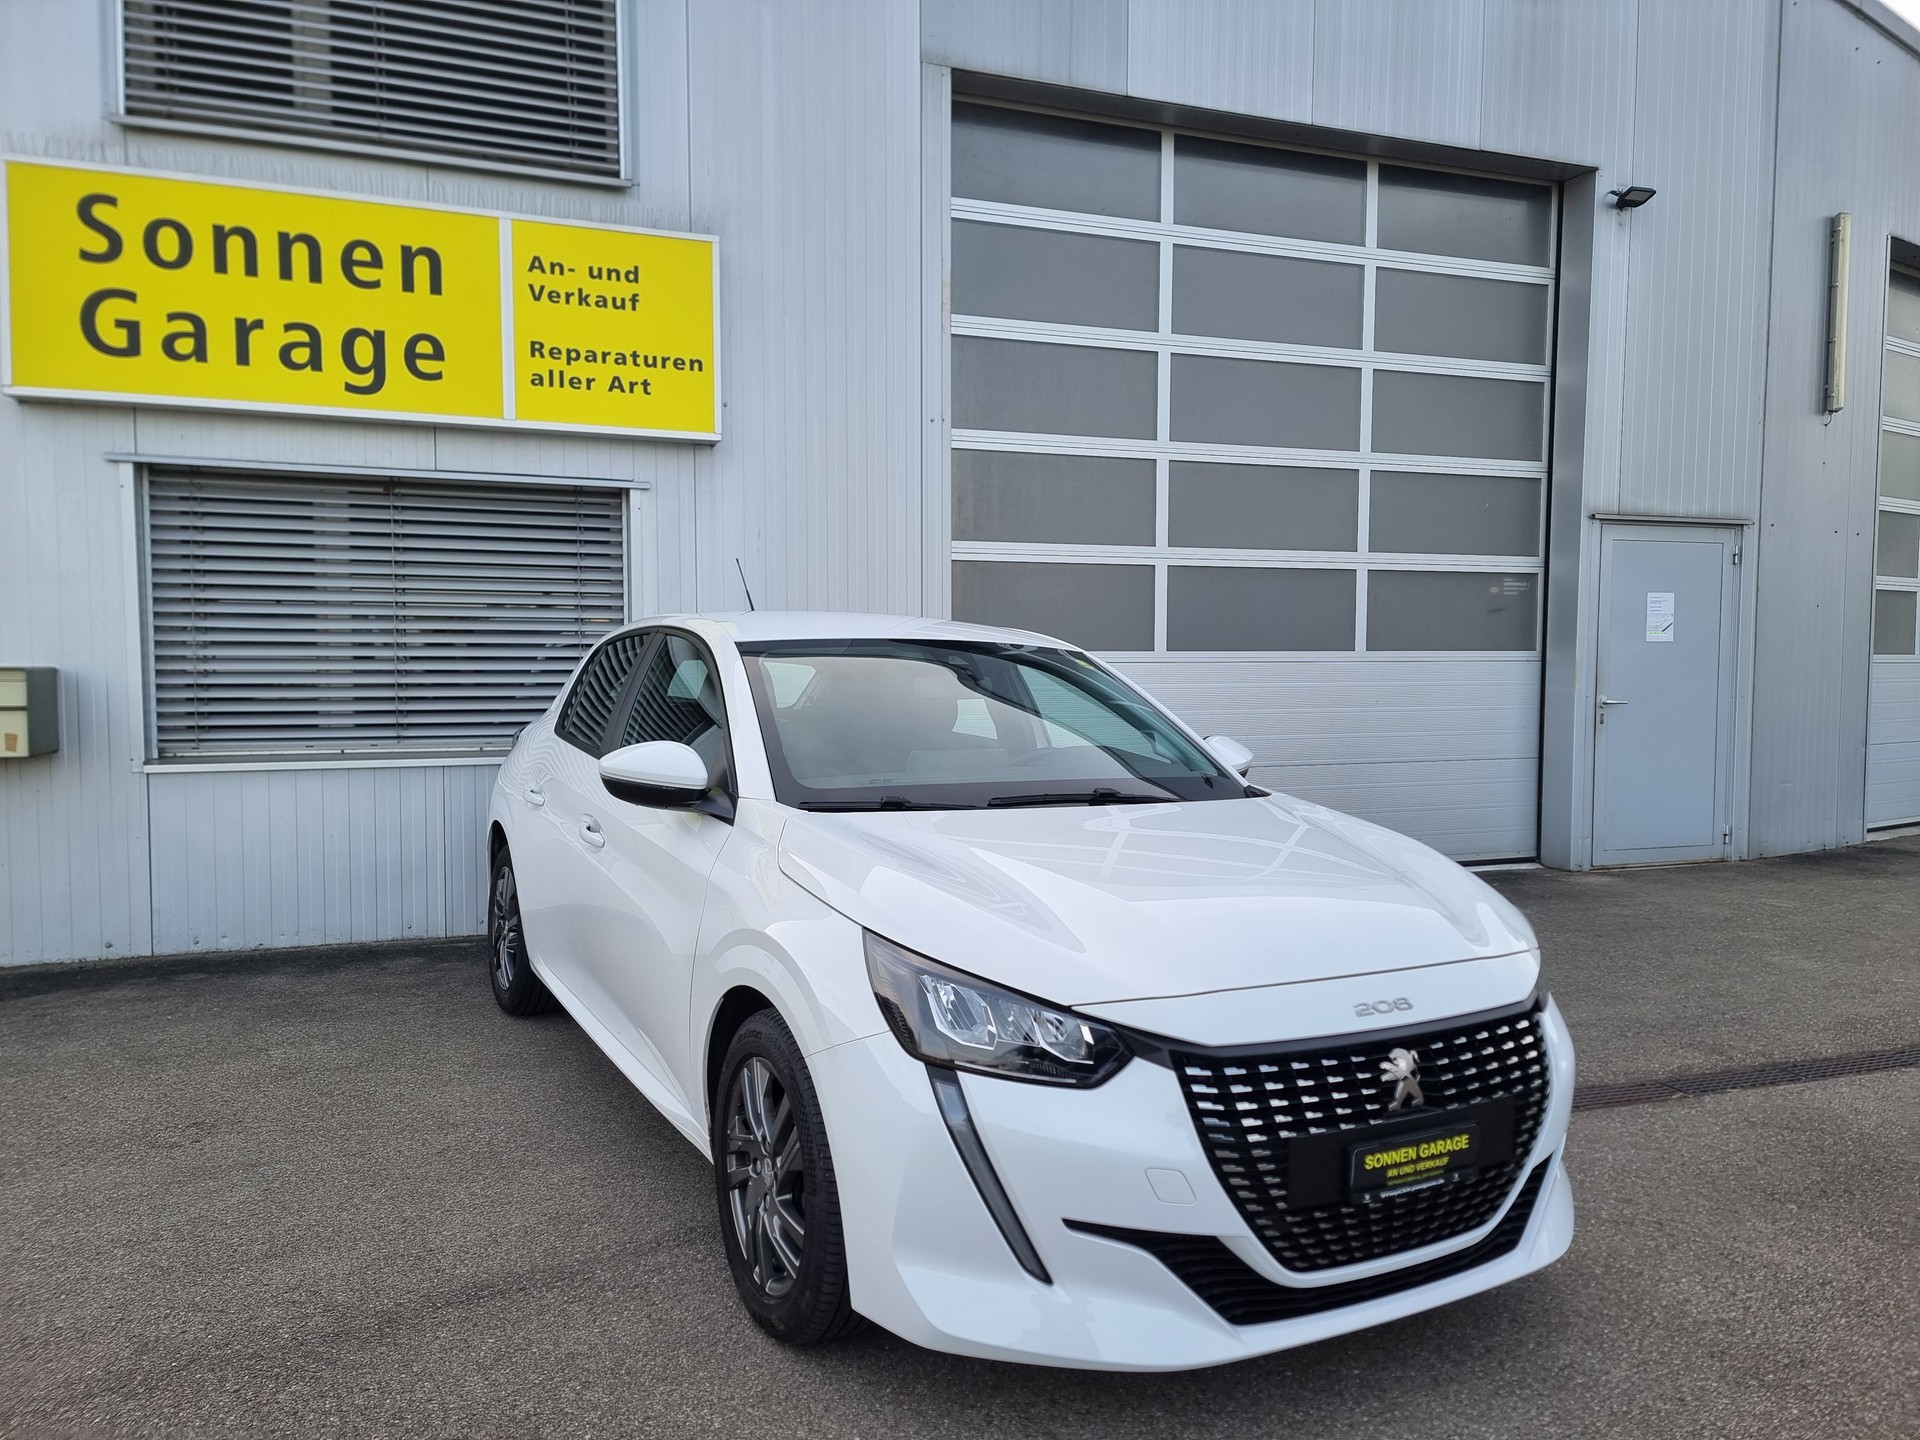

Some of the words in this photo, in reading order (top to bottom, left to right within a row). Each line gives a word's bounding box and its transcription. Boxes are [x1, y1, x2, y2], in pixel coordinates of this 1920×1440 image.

[76, 192, 443, 296] Sonnen
[527, 255, 576, 276] An-
[588, 265, 640, 284] und
[528, 283, 640, 312] Verkauf
[79, 288, 445, 396] Garage
[529, 340, 704, 372] Reparaturen
[530, 369, 596, 391] aller
[607, 375, 652, 396] Art
[1352, 997, 1414, 1018] 208
[1364, 1146, 1418, 1170] SONNEN
[1418, 1133, 1470, 1158] GARAGE
[1386, 1167, 1399, 1178] AN
[1400, 1162, 1415, 1175] UND
[1416, 1156, 1450, 1171] VERKAUF
